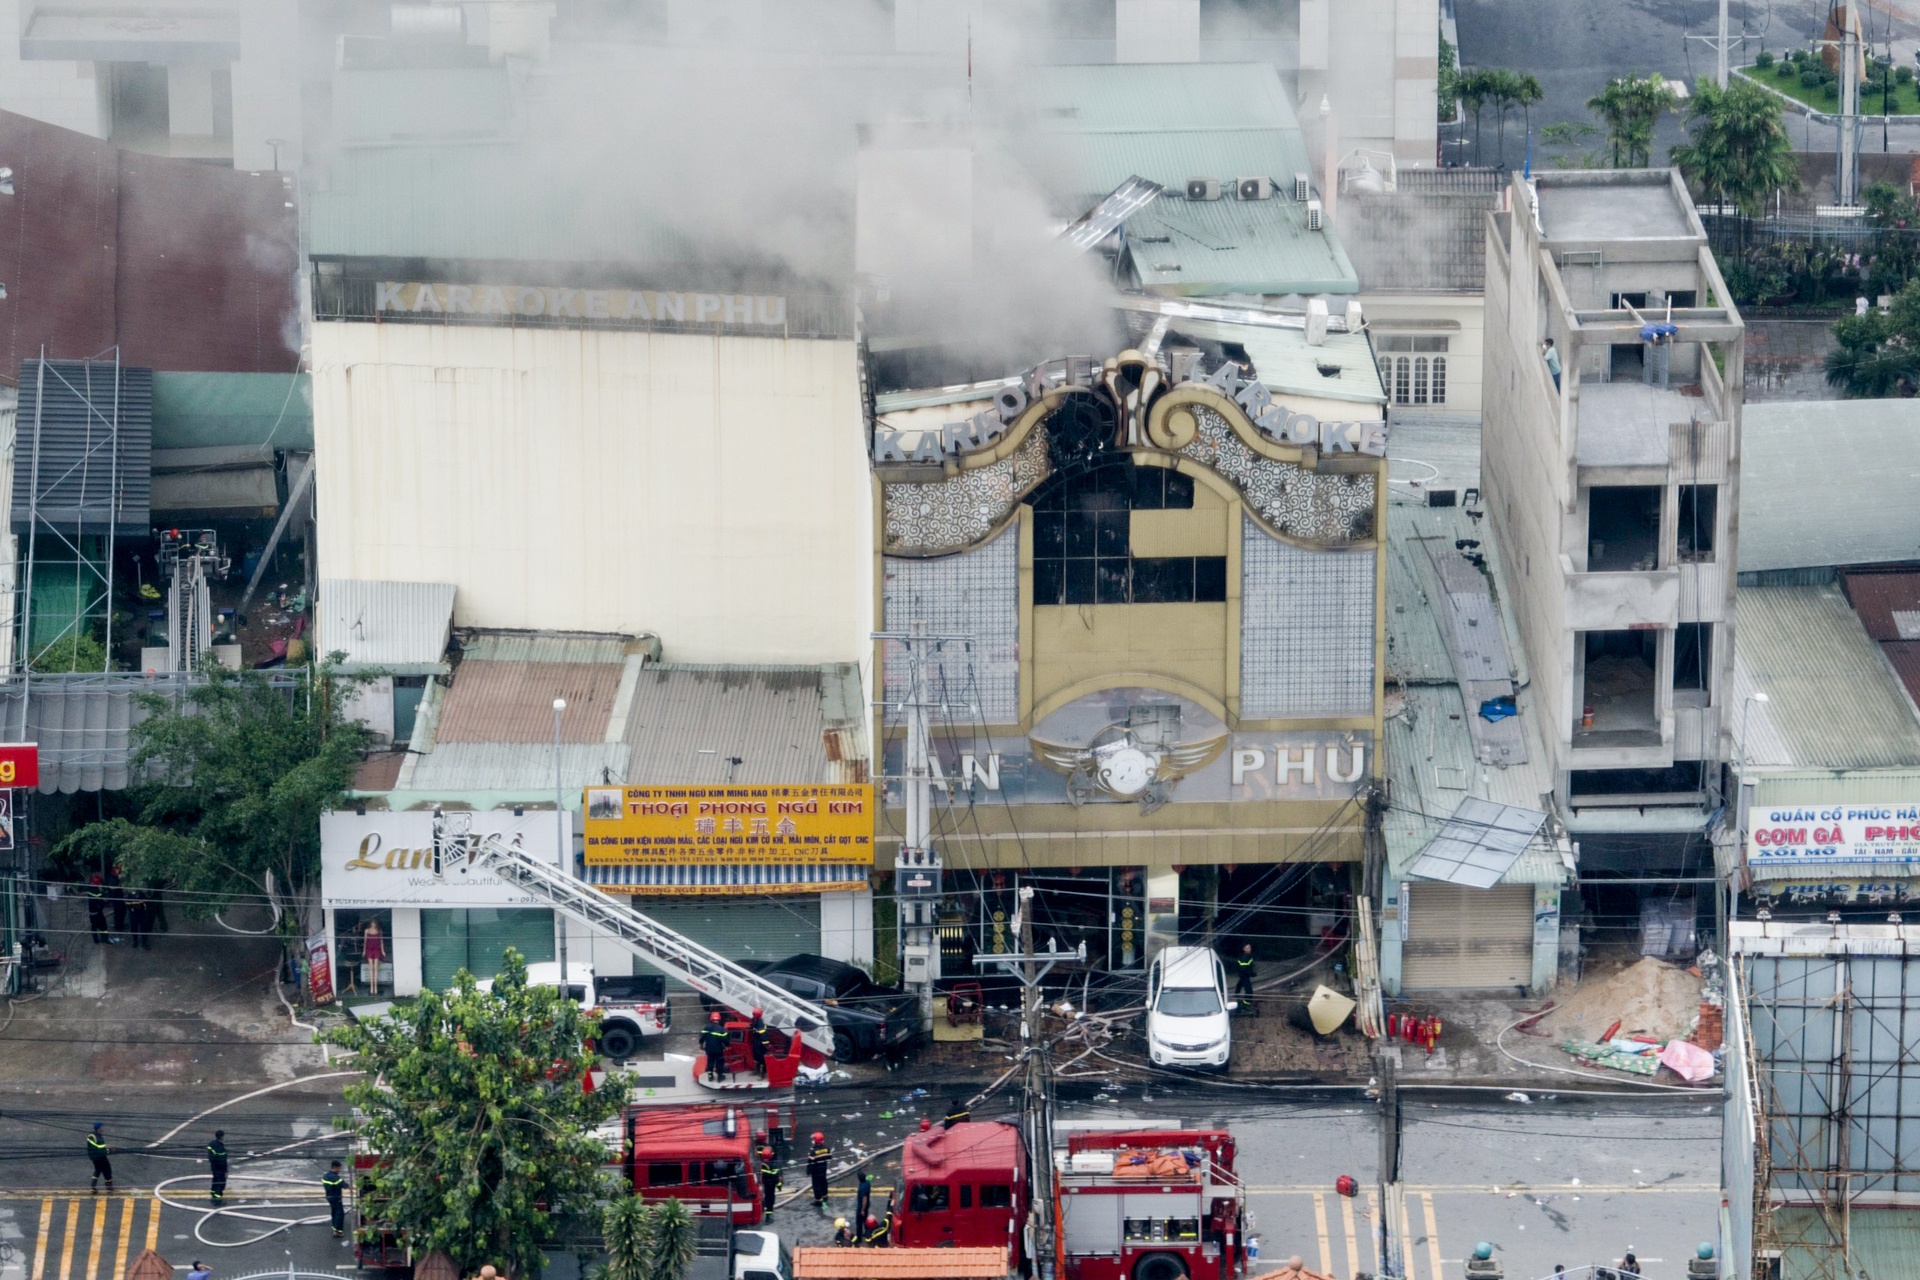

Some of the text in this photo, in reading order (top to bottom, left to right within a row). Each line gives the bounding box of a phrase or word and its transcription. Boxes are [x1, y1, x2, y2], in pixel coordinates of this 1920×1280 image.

[375, 281, 609, 320] KARAOKE
[624, 289, 685, 323] AN
[874, 354, 1093, 462] KARAOKE
[1171, 351, 1388, 457] KARAOKE
[628, 789, 651, 798] CÔNG
[653, 790, 662, 798] TY
[665, 789, 687, 798] TNHH
[709, 789, 724, 798] KIM
[727, 789, 748, 798] MING
[751, 789, 768, 798] HAO
[628, 798, 863, 818] THOẠI PHONG NGŨ KIM
[1770, 809, 1815, 822] QUÁN
[1848, 806, 1891, 820] PHÚC
[1897, 805, 1920, 822] HẬ
[695, 816, 797, 836] 瑞丰五金
[1754, 823, 1846, 846] CƠM GÀ
[588, 836, 599, 846] GIA
[601, 835, 618, 846] CÔNG
[697, 835, 710, 845] CÁC
[712, 836, 727, 846] LOẠI
[855, 836, 869, 844] CNC
[1758, 846, 1797, 857] XỐI
